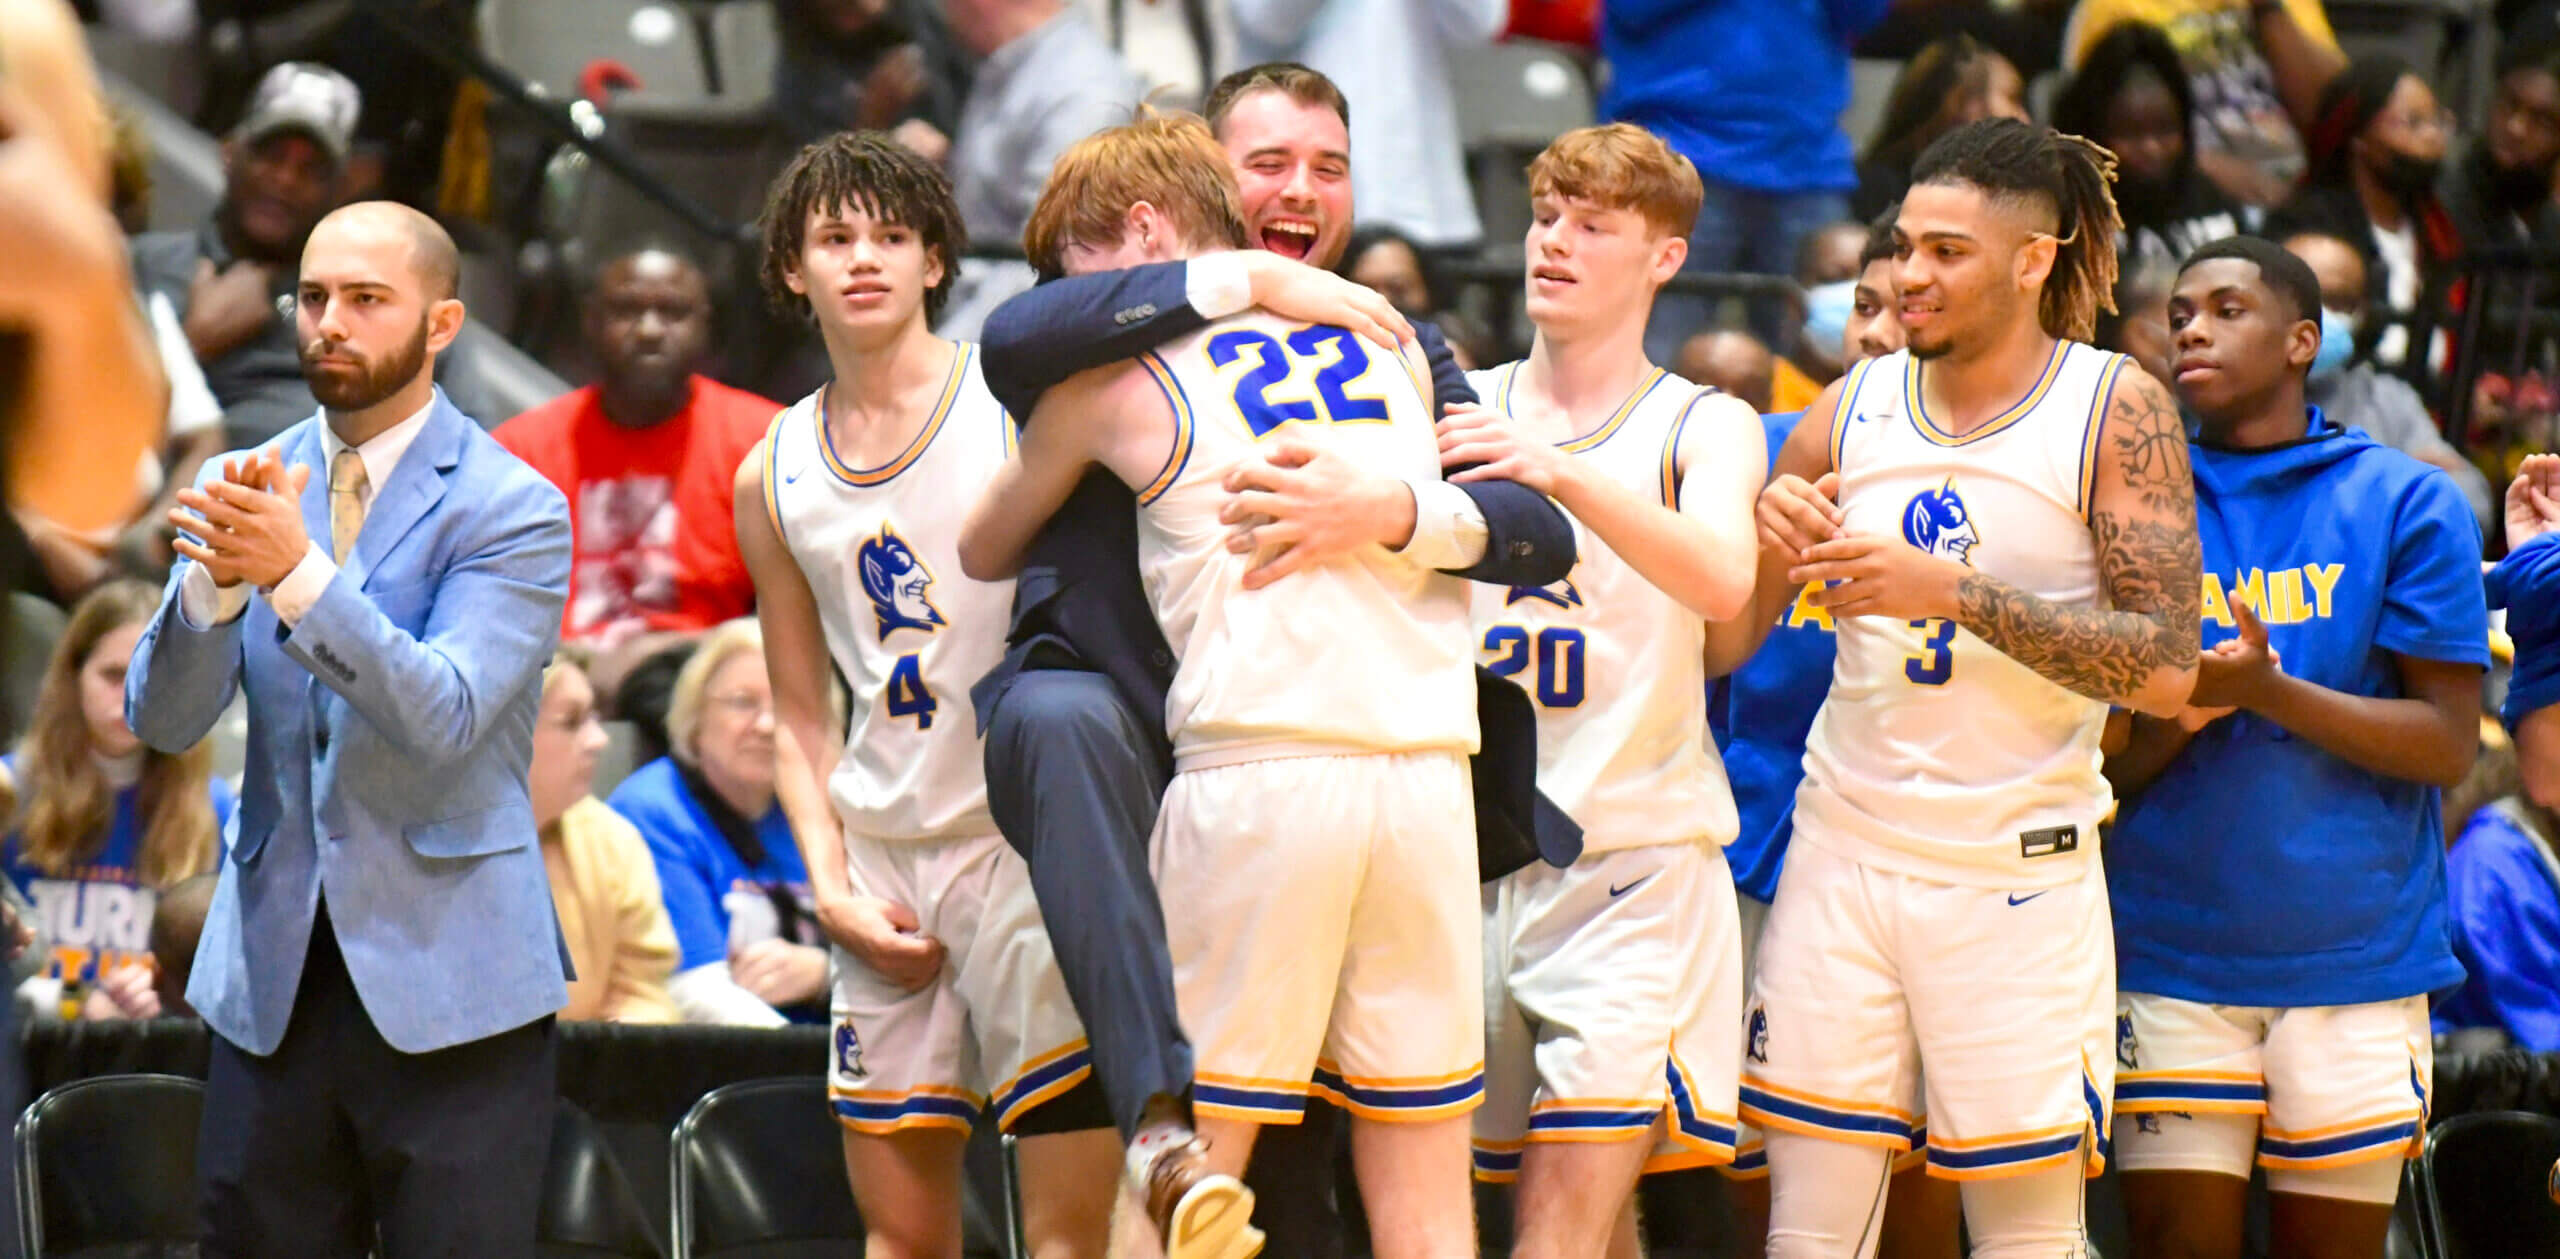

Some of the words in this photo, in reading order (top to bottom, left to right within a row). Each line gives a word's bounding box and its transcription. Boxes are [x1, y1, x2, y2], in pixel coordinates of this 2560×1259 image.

[1206, 323, 1391, 440] 22
[2201, 563, 2345, 627] AMILY
[1483, 624, 1586, 708] 20
[1903, 617, 1957, 686] 3
[887, 652, 938, 730] 4
[2061, 833, 2072, 847] M
